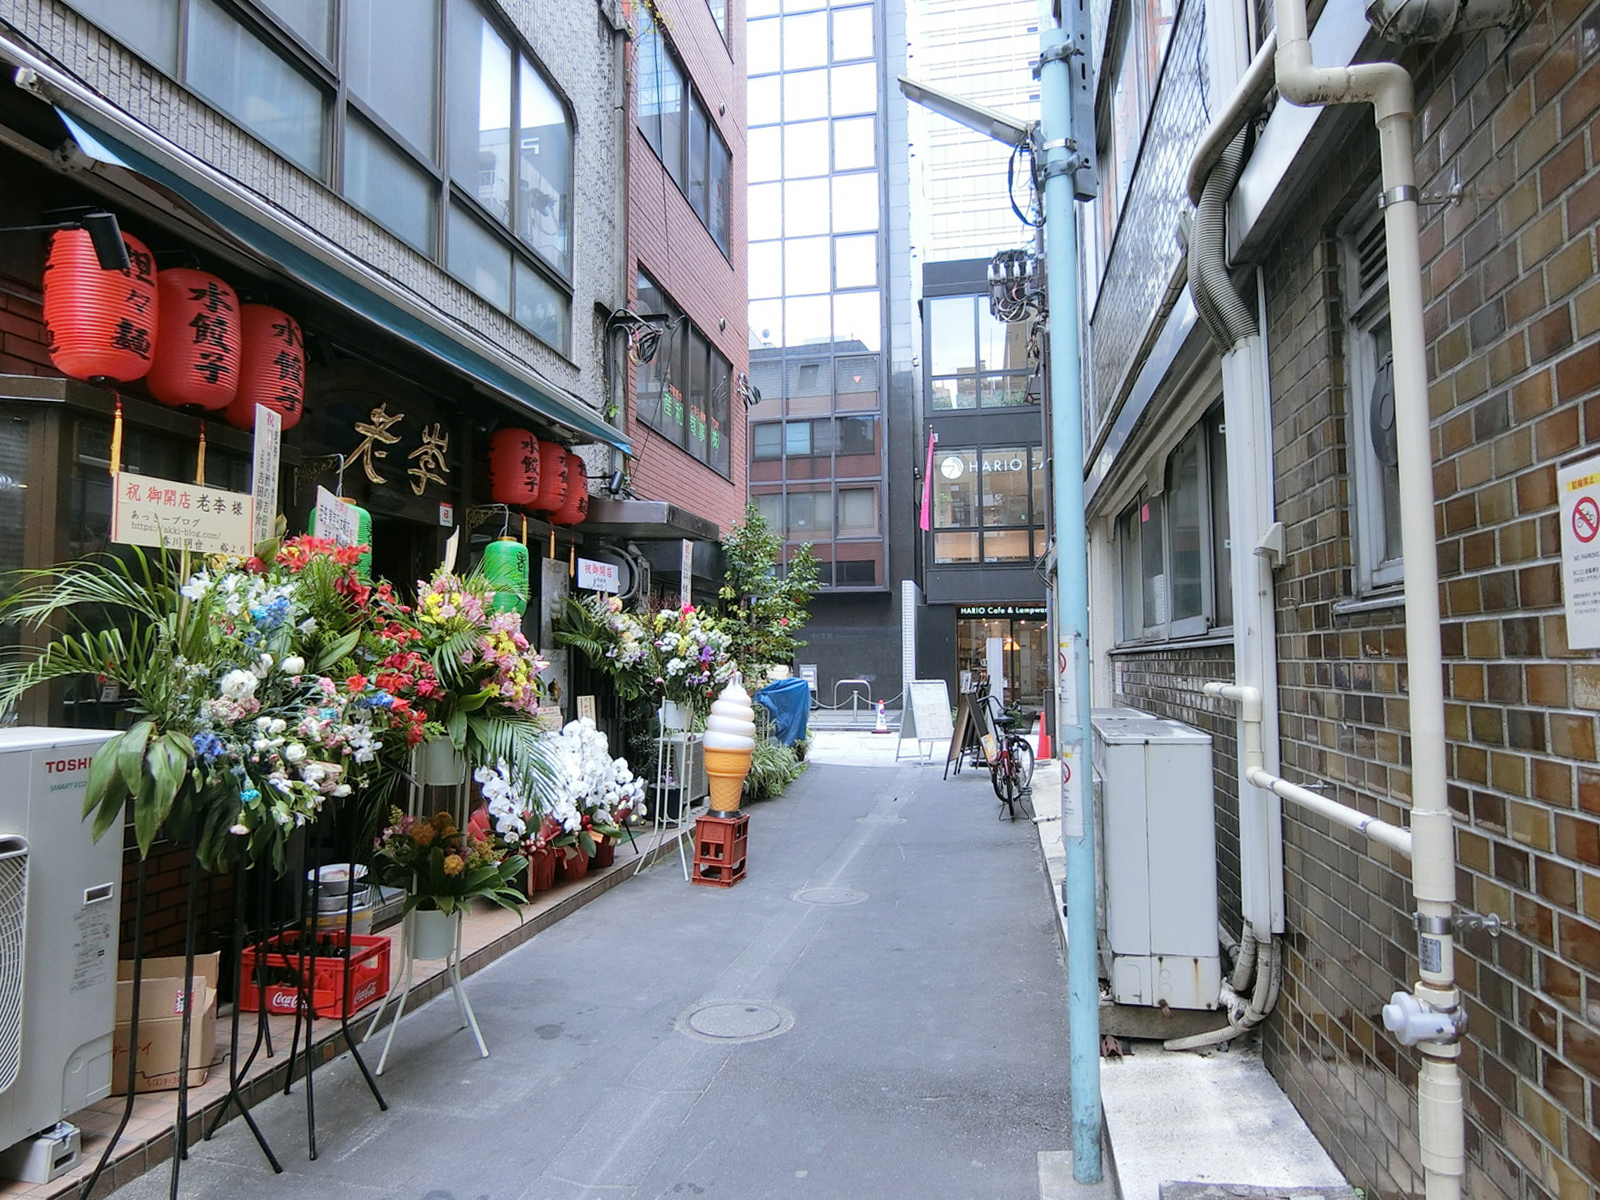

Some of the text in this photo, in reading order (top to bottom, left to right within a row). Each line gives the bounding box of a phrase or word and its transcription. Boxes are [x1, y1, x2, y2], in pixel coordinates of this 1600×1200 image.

[187, 281, 234, 384] 水餃子
[271, 317, 303, 412] 水餃子
[520, 436, 539, 493] 水餃子
[969, 458, 1023, 473] HARIO
[125, 482, 141, 502] 祝
[146, 486, 191, 509] 御開店
[960, 607, 985, 615] HARIO
[49, 782, 73, 792] SMART
